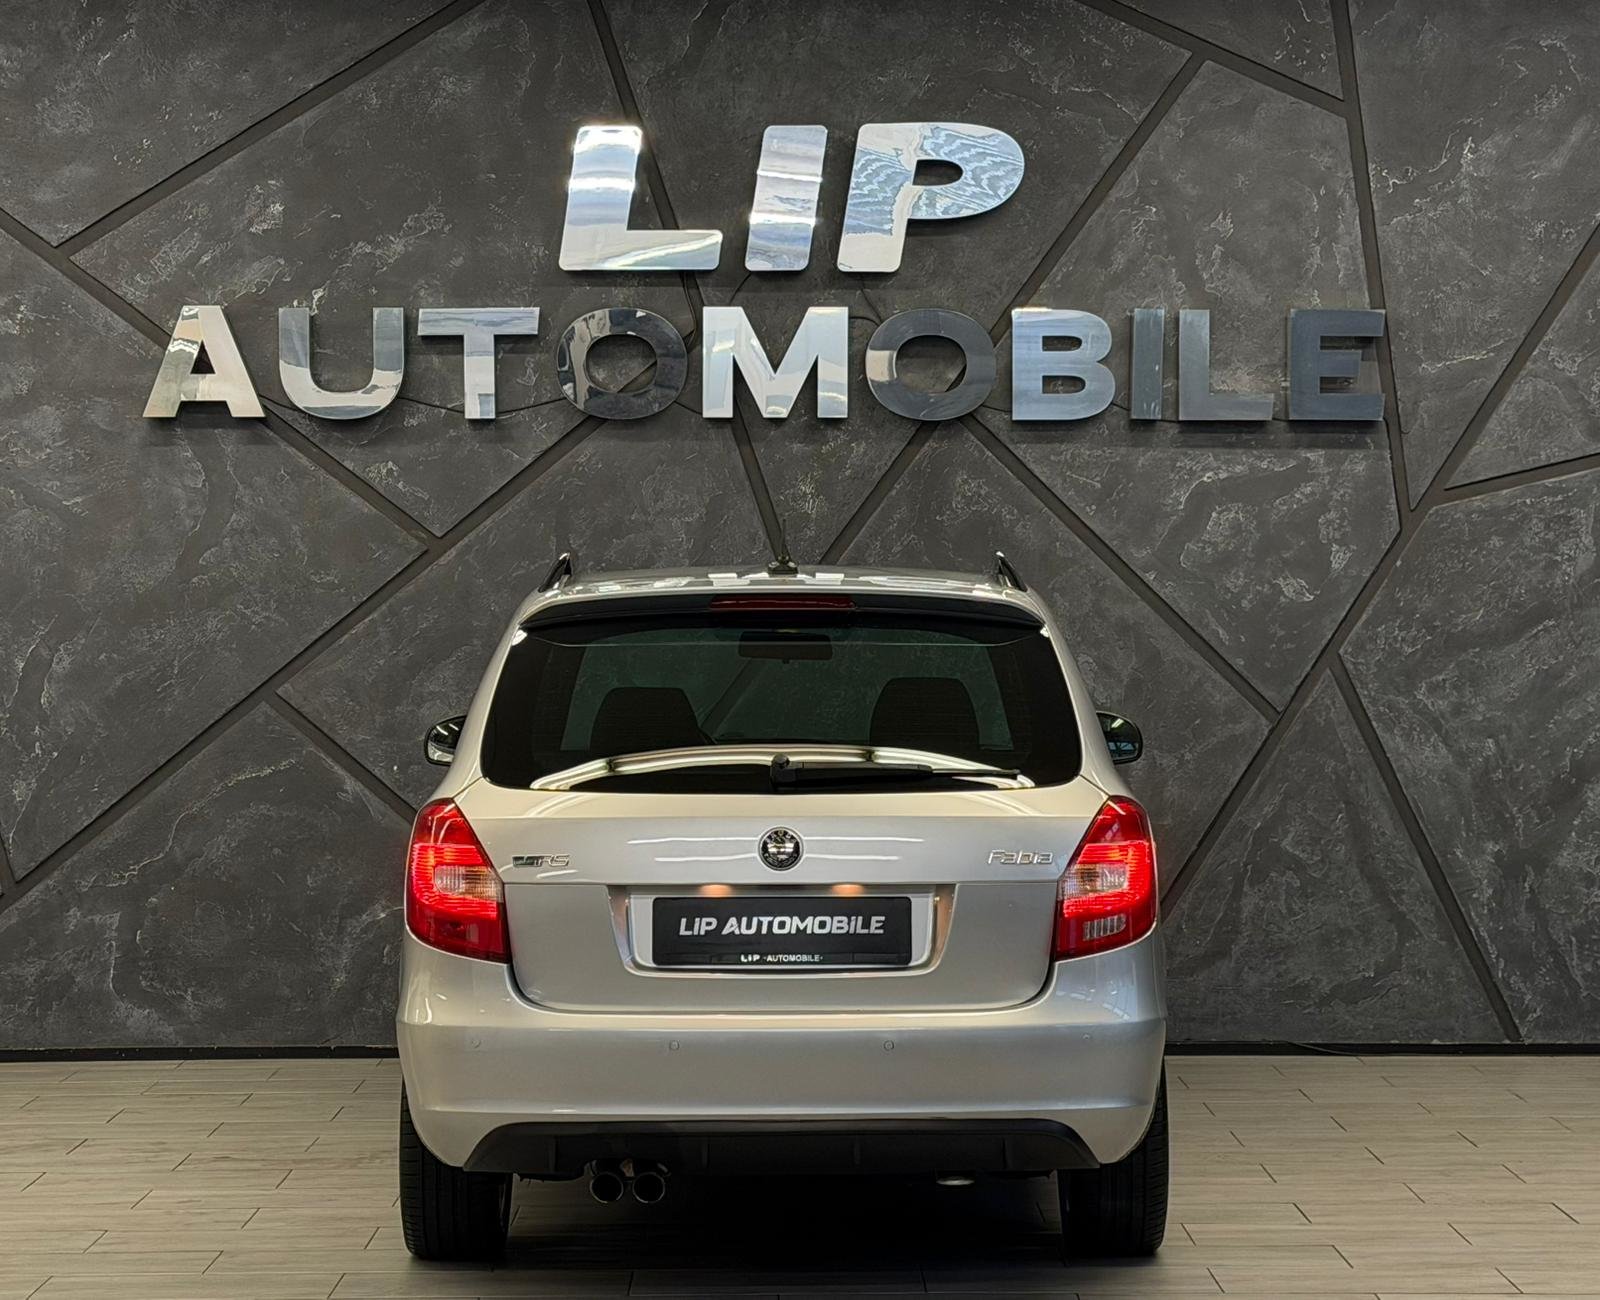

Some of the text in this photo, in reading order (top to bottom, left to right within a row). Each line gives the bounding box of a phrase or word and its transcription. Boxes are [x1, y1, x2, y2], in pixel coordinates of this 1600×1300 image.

[559, 122, 1025, 273] LIP
[143, 304, 1386, 421] AUTOMOBILE
[987, 849, 1053, 864] Fabia
[679, 915, 886, 936] LIP AUTOMOBILE
[740, 954, 760, 962] LIP
